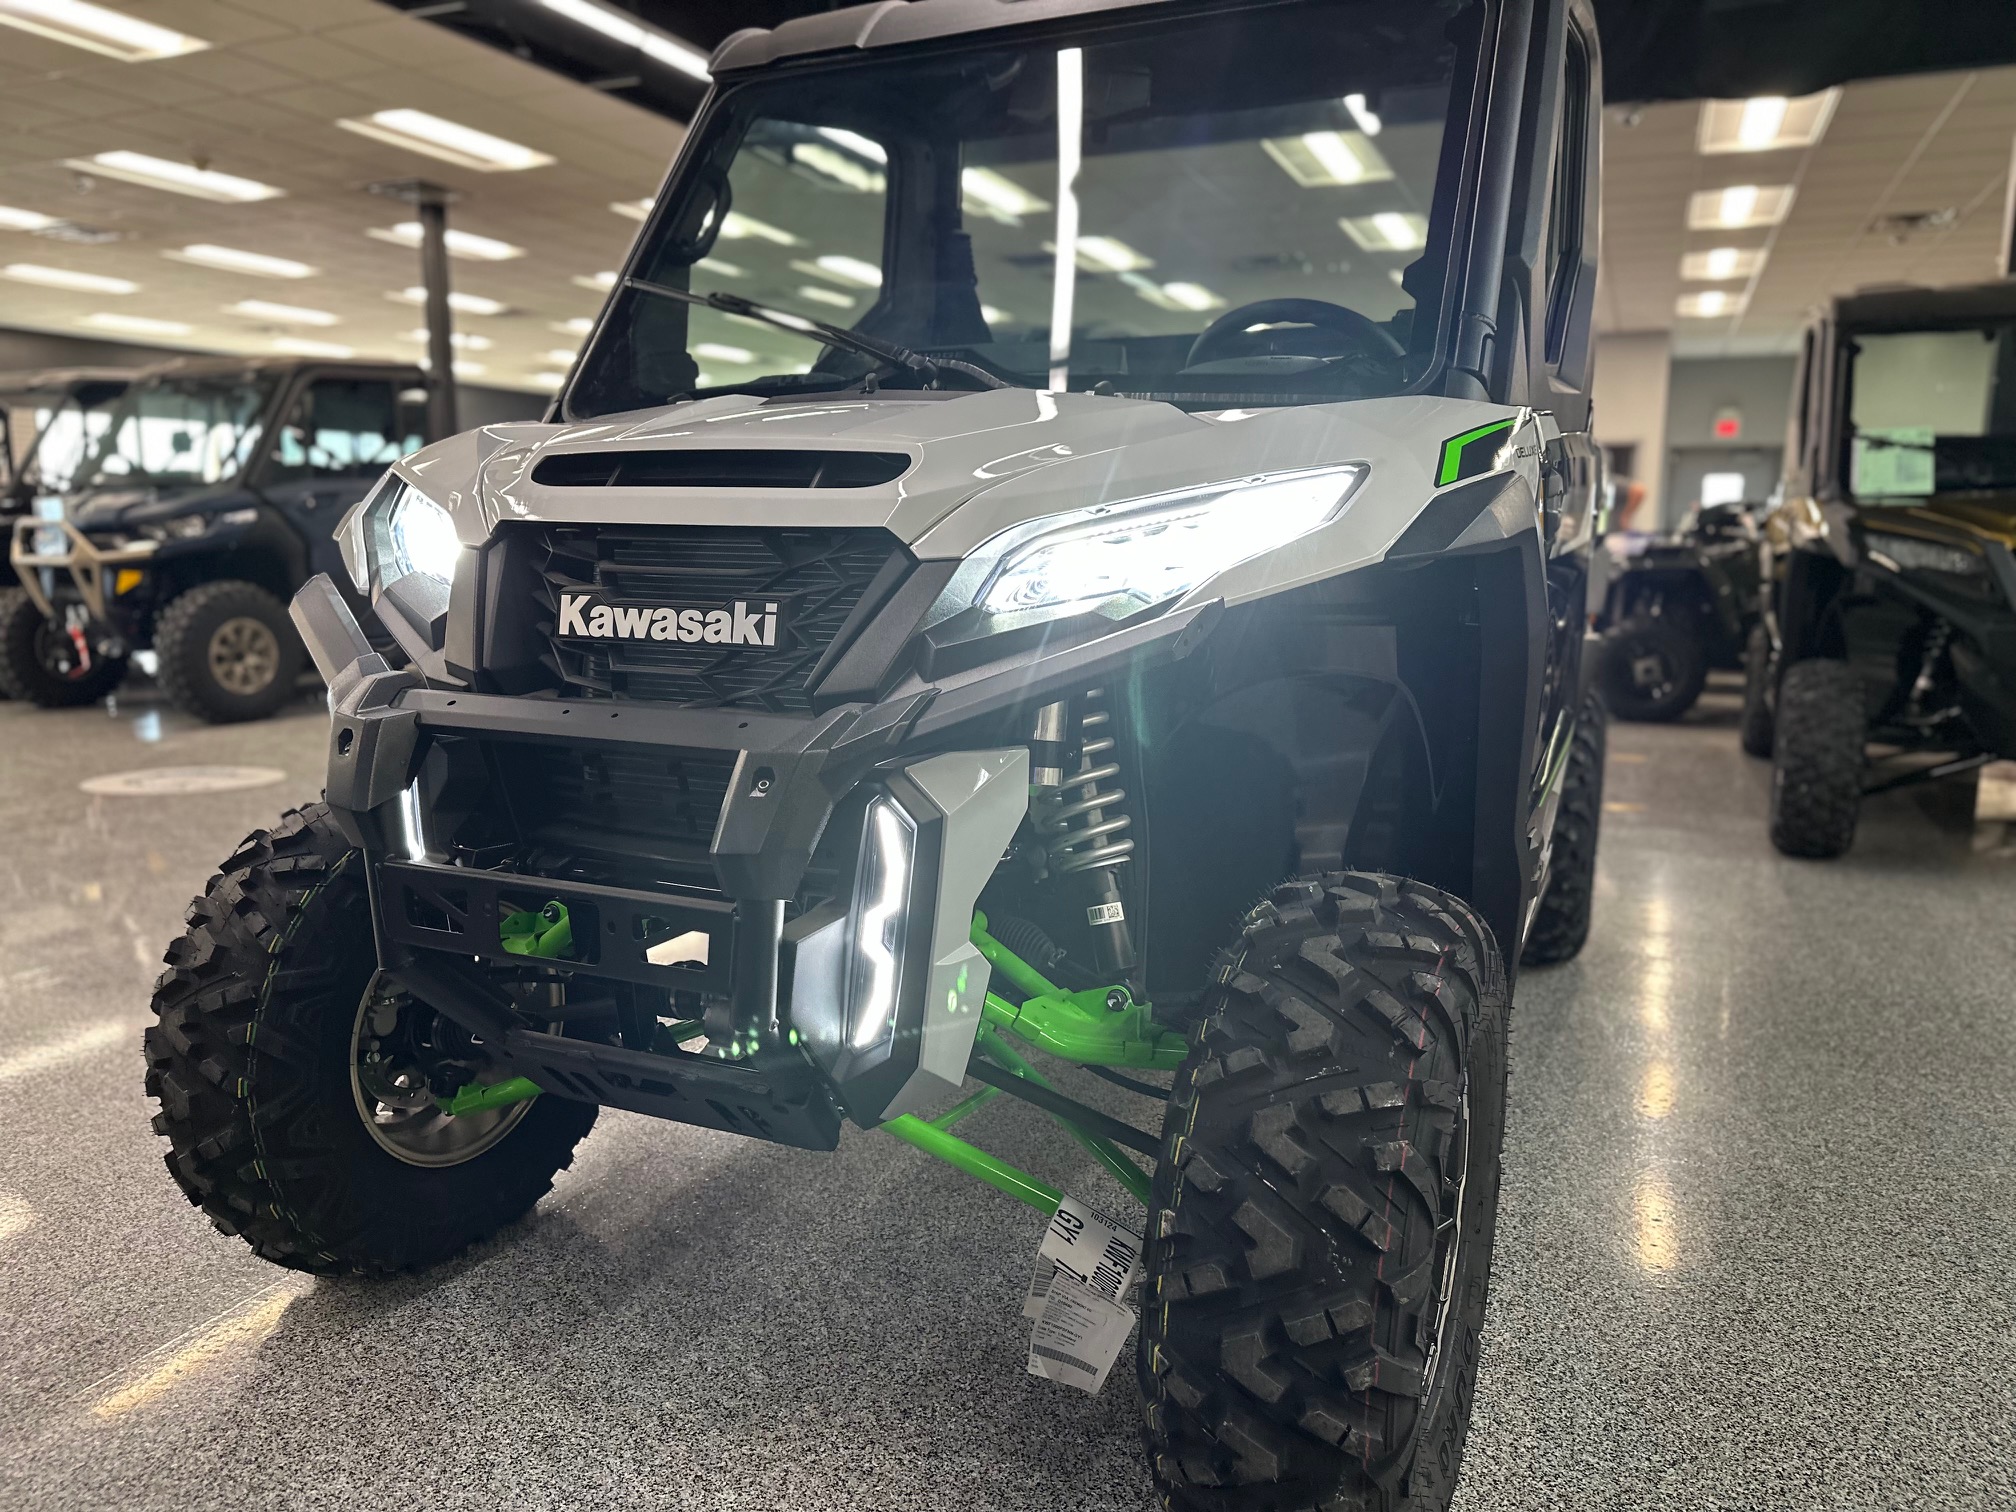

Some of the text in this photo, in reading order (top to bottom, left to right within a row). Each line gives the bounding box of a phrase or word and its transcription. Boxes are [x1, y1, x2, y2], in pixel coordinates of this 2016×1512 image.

[558, 594, 778, 646] Kawasaki
[1050, 1208, 1084, 1246] GY1
[1090, 1212, 1118, 1232] 103124
[1438, 1323, 1474, 1479] DURO
